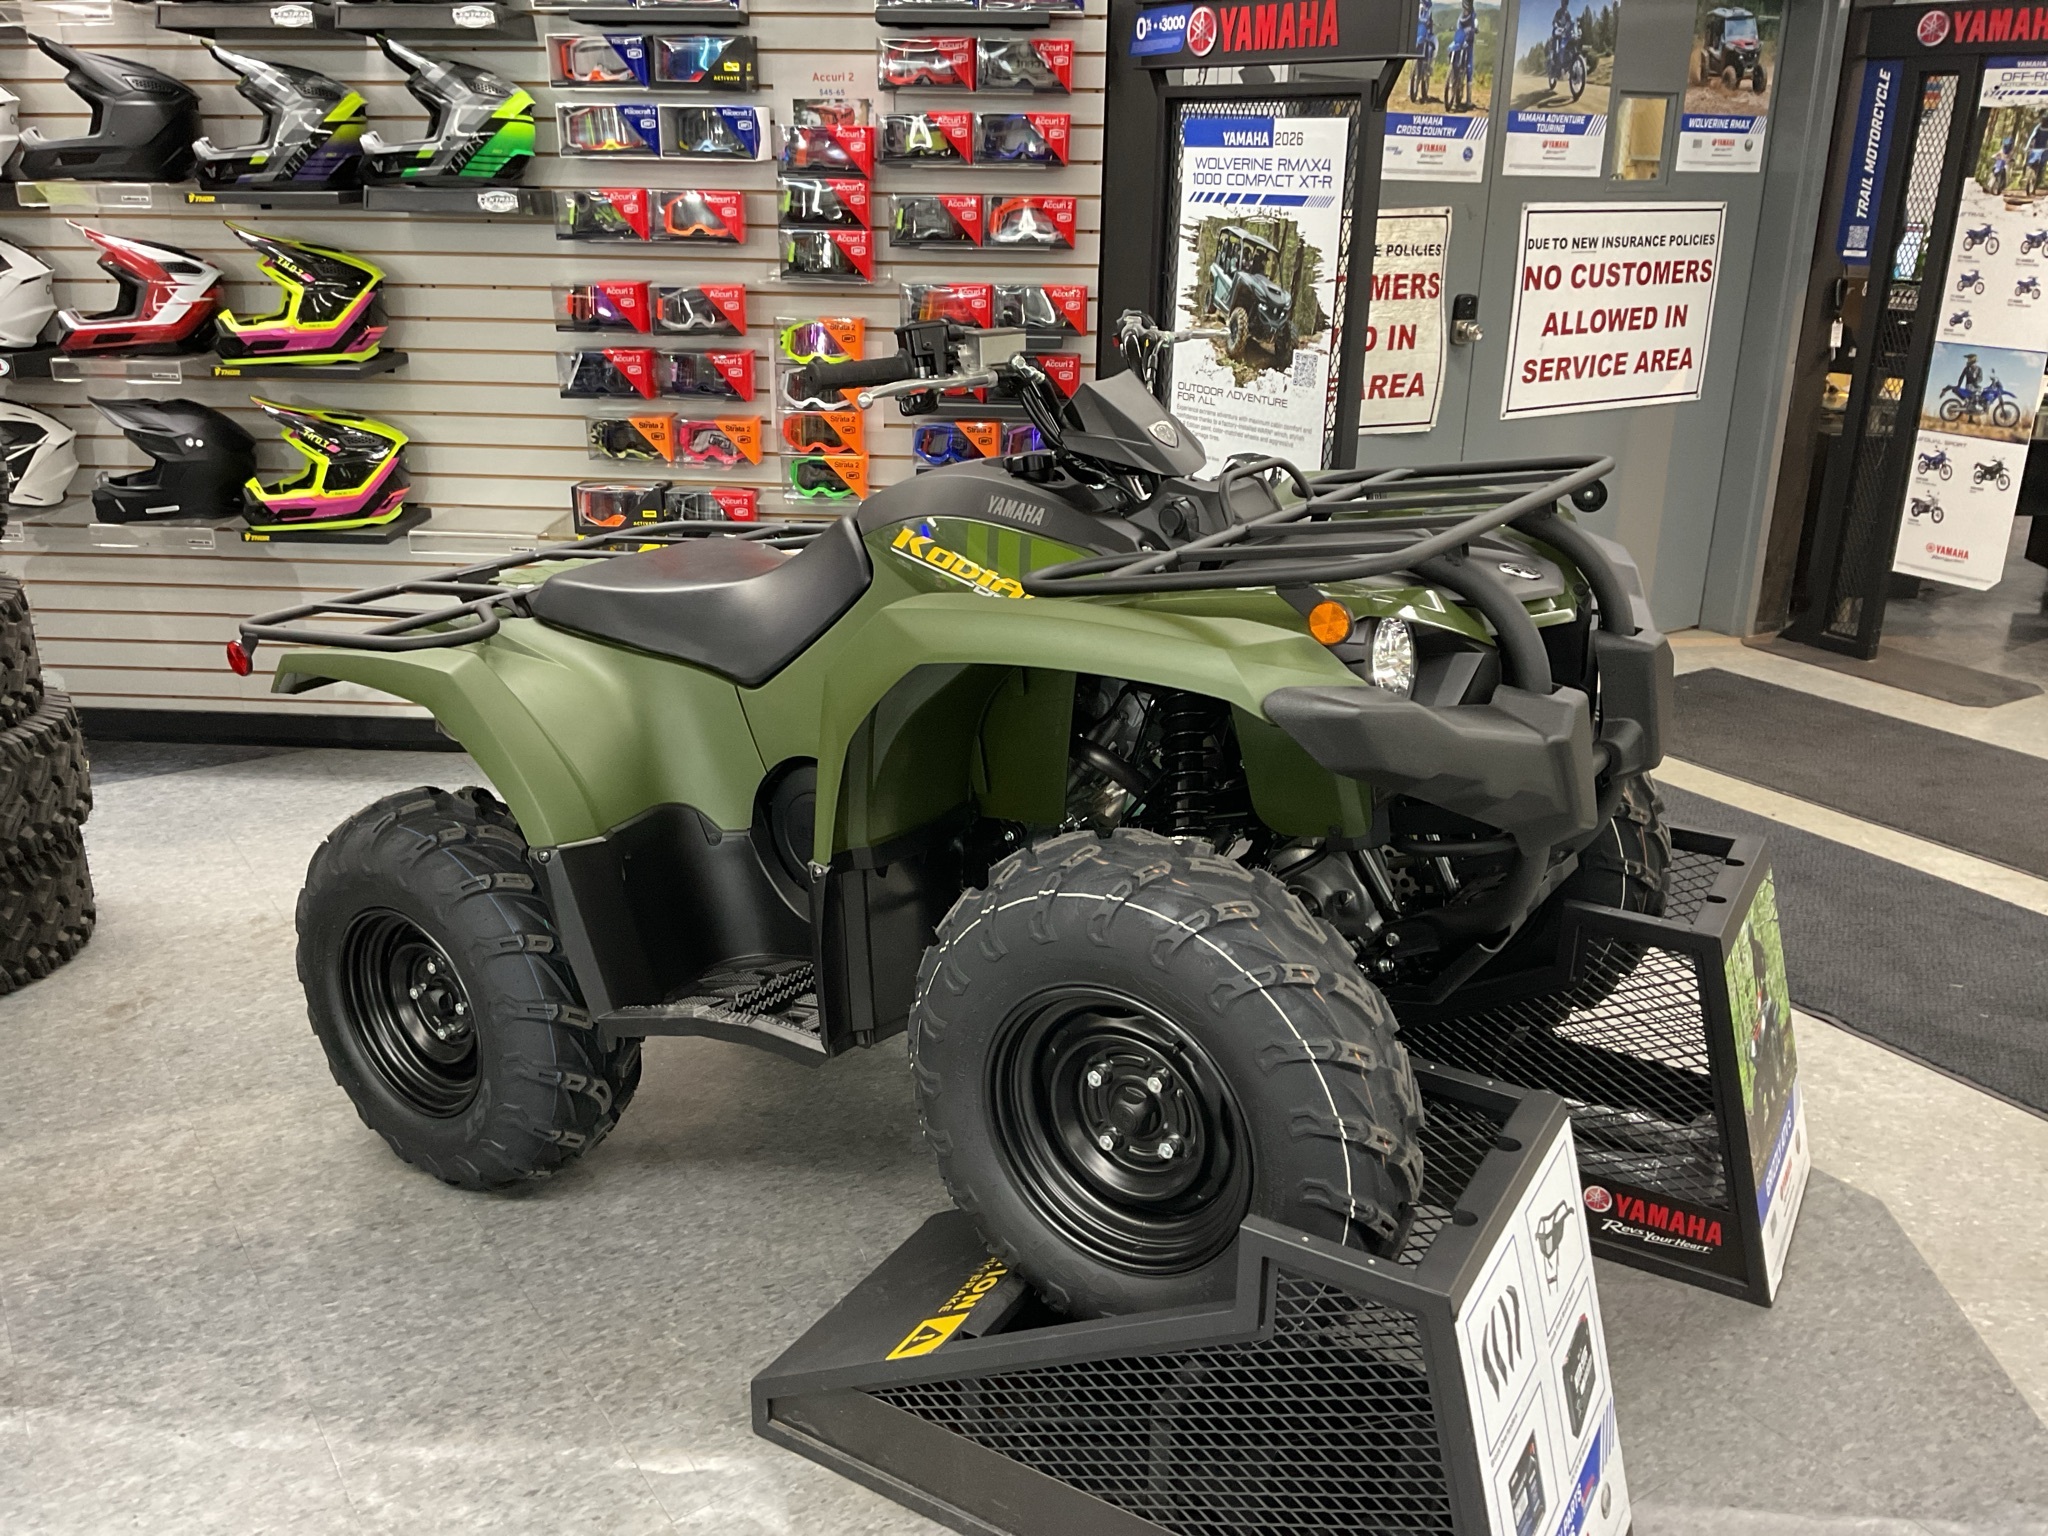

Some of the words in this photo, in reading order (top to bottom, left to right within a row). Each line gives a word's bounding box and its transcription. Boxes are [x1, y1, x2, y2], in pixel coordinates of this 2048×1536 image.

[1220, 0, 1338, 52] YAMAHA
[812, 72, 845, 81] Accuri
[848, 72, 854, 81] 2
[1413, 116, 1443, 126] YAMAHA
[1518, 112, 1545, 123] YAMAHA
[1546, 114, 1586, 124] ADVENTURE
[1688, 118, 1729, 129] WOLVERINE
[1730, 120, 1751, 129] RMAX
[1864, 68, 1891, 173] MOTORCYCLE
[1396, 125, 1421, 135] CROSS
[1422, 126, 1457, 137] COUNTRY
[1536, 124, 1565, 133] TOURING
[1223, 132, 1269, 146] YAMAHA
[1274, 132, 1304, 146] 2026
[1424, 144, 1446, 153] YAMAHA
[1195, 157, 1273, 171] WOLVERINE
[1278, 158, 1331, 172] RMAX4
[1193, 172, 1222, 185] 1000
[1226, 174, 1294, 187] COMPACT
[1299, 175, 1333, 189] XT-R
[1856, 176, 1874, 219] TRAIL
[1528, 238, 1549, 250] DUE
[1552, 238, 1568, 249] TO
[1572, 236, 1599, 249] NEW
[1602, 235, 1666, 248] INSURANCE
[1669, 234, 1715, 247] POLICIES
[1386, 244, 1441, 257] POLICIES
[1524, 264, 1562, 291] NO
[1570, 259, 1713, 289] CUSTOMERS
[1541, 306, 1658, 337] ALLOWED
[1664, 304, 1689, 329] IN
[1388, 324, 1417, 351] IN
[1522, 352, 1629, 384] SERVICE
[1634, 347, 1693, 374] AREA
[1361, 372, 1425, 400] REA
[1178, 382, 1224, 397] OUTDOOR
[1226, 390, 1288, 408] ADVENTURE
[1178, 392, 1195, 401] FOR
[1198, 395, 1216, 406] ALL
[987, 495, 1046, 526] YAMAHA
[1936, 545, 1968, 560] YAMAHA
[1616, 1193, 1722, 1246] YAMAHA
[1601, 1218, 1644, 1236] Revs
[1674, 1239, 1711, 1252] Heart
